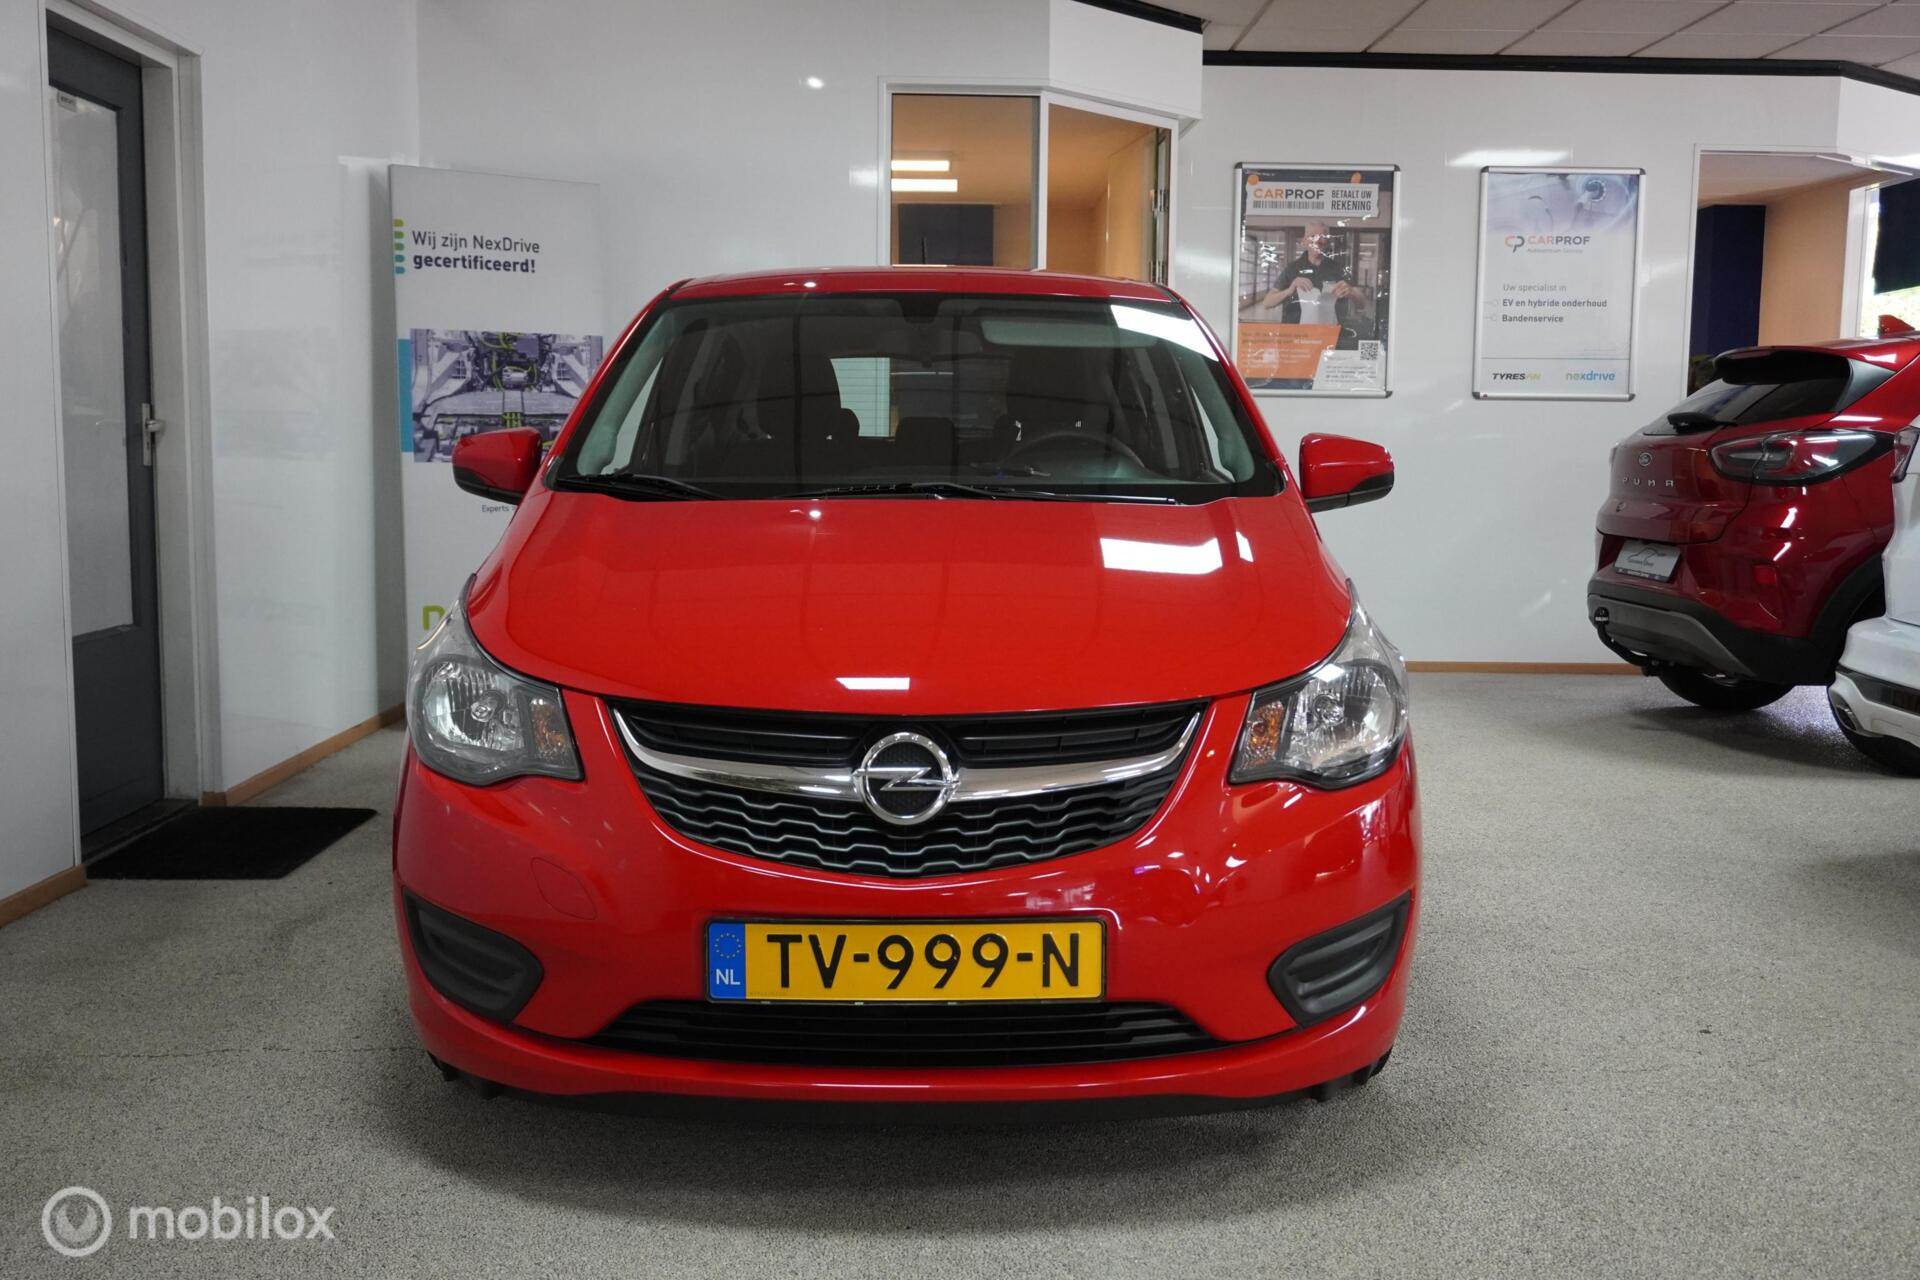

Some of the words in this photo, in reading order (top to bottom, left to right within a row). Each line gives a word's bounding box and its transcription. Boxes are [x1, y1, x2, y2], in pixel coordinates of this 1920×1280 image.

[1253, 188, 1324, 200] CARPROF
[1331, 190, 1359, 199] BETAALT
[1360, 190, 1372, 199] UW
[1331, 200, 1371, 211] REKENING
[412, 230, 436, 250] Wij
[441, 233, 468, 251] zijn
[473, 235, 540, 253] NexDrive
[1527, 235, 1591, 245] CARPROF
[413, 254, 536, 273] gecertificeerd!
[1518, 283, 1557, 293] specialist
[1502, 299, 1513, 307] EV
[1528, 299, 1560, 308] hybride
[1561, 299, 1607, 307] onderhoud
[1502, 314, 1564, 323] Bandenservice
[1565, 370, 1616, 381] nexdrive
[1622, 476, 1674, 487] PUMA
[481, 504, 509, 513] Experts
[716, 968, 741, 985] NL
[766, 932, 1080, 990] TV-999-N
